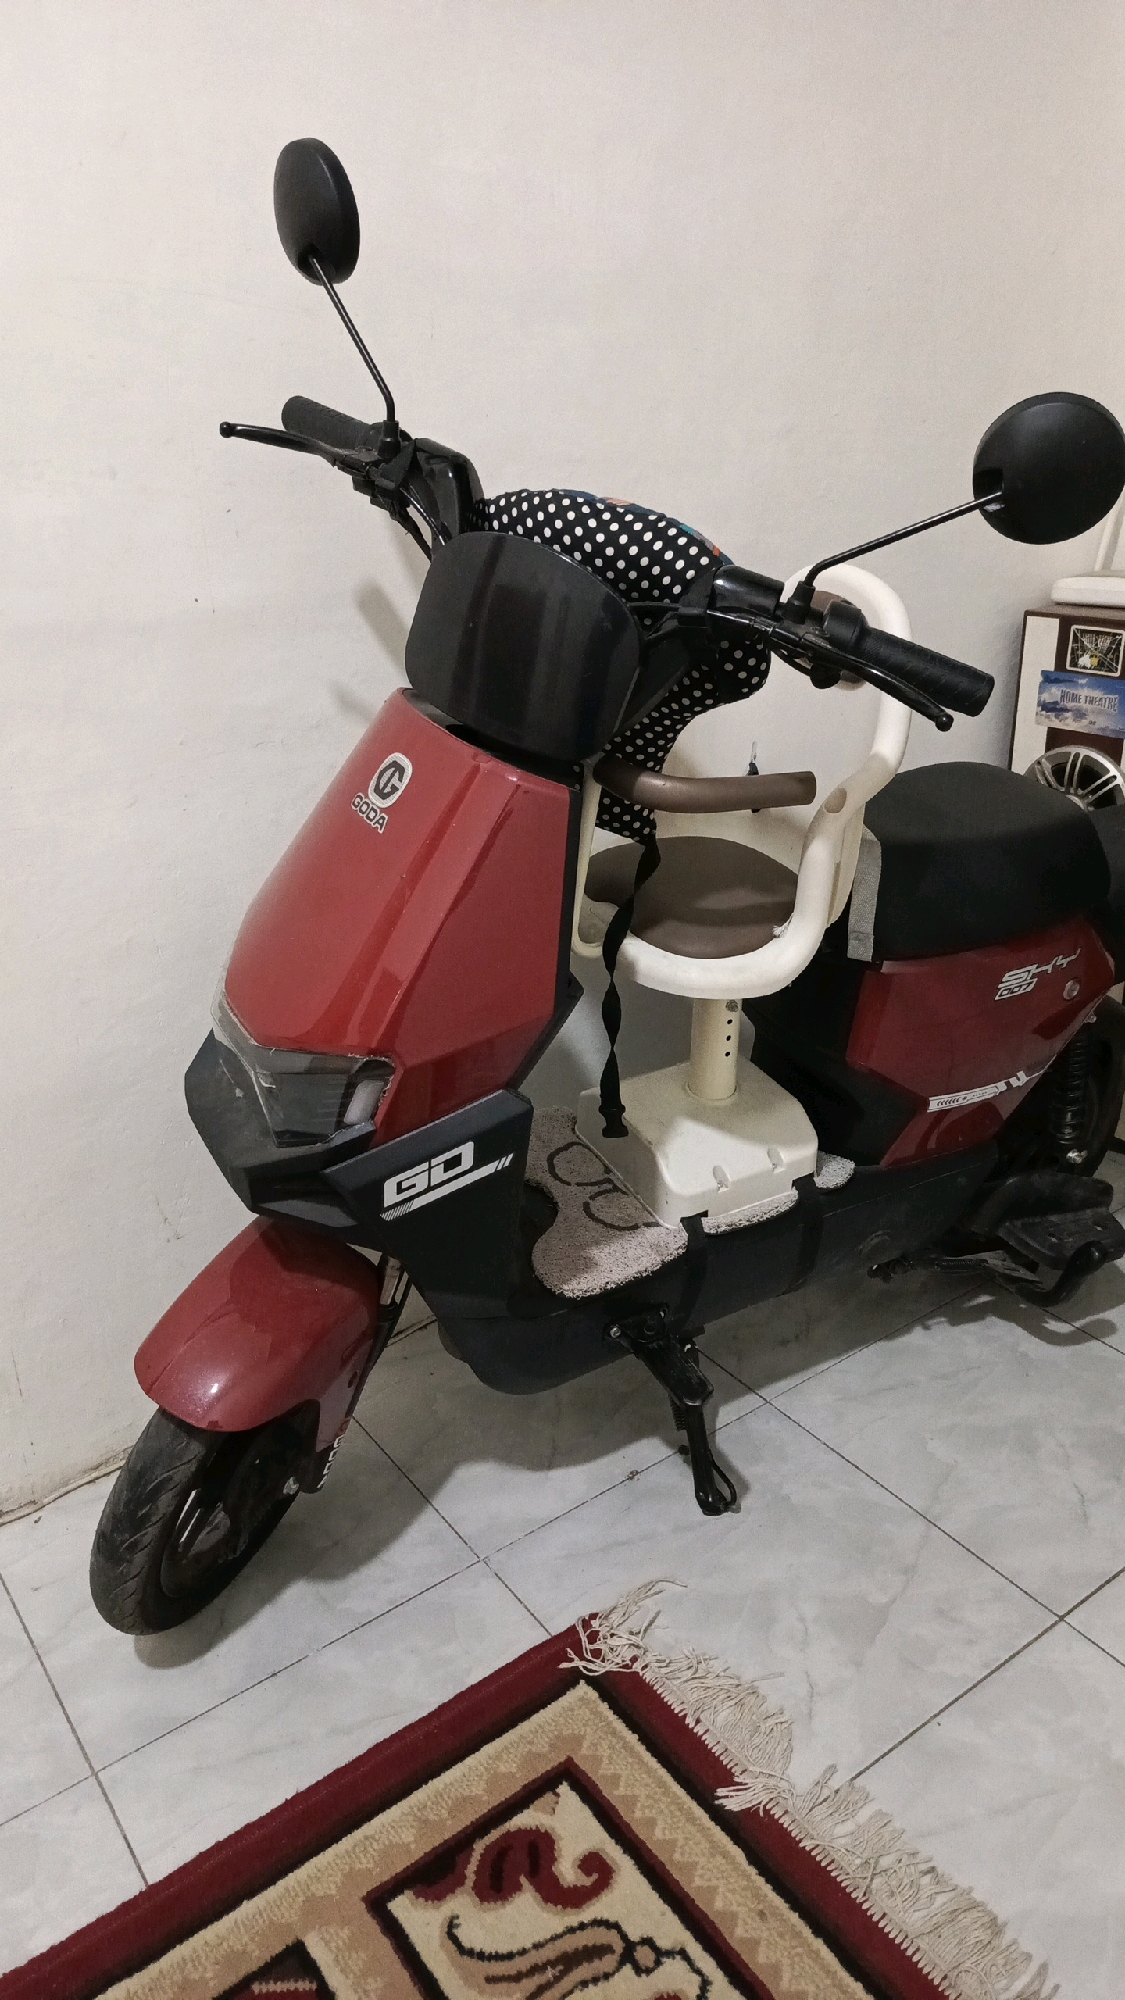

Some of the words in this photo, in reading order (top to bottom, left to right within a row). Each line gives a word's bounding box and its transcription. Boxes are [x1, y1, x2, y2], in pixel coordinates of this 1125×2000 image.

[1060, 689, 1082, 705] HOME
[1084, 694, 1118, 713] THEATRE
[351, 793, 387, 832] GODA
